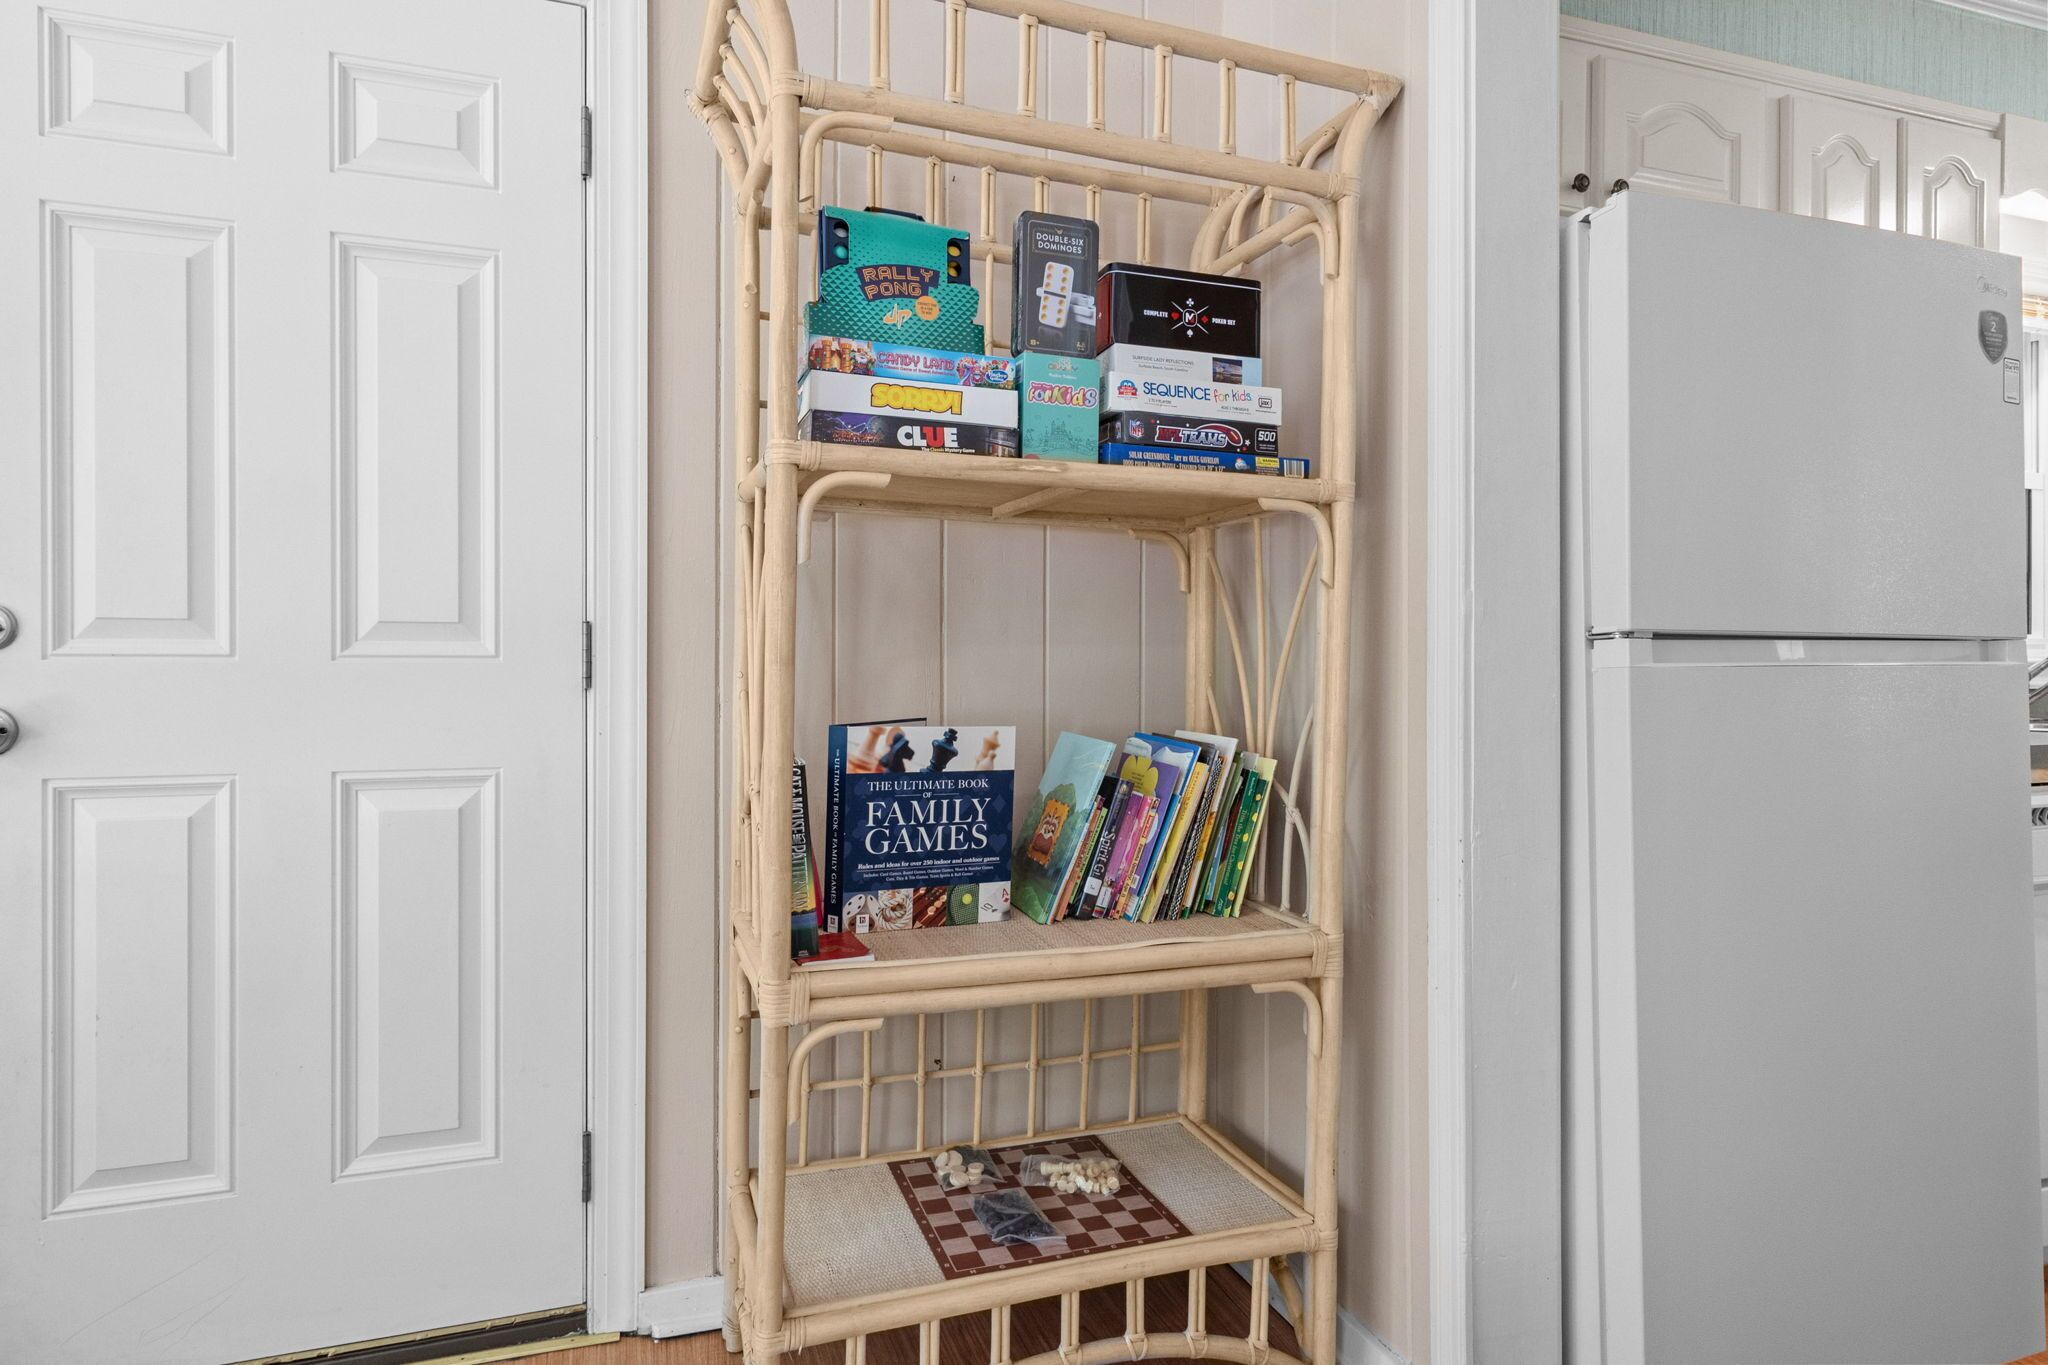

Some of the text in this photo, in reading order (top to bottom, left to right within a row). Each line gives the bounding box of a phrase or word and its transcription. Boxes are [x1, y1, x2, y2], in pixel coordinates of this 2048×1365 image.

[1036, 233, 1084, 246] DOUBLE-SIX
[1038, 241, 1082, 254] DOMINOES
[863, 266, 934, 283] RALLY
[864, 282, 922, 299] PONG
[1143, 309, 1169, 318] COMPLETE
[1212, 317, 1227, 325] POKER
[1990, 321, 1997, 332] 2
[877, 352, 955, 371] CANDY LAND
[870, 382, 963, 415] SORRY!
[1143, 382, 1211, 400] SEQUENCE
[1213, 389, 1230, 403] for
[1231, 389, 1252, 401] kids
[897, 425, 960, 447] CLUE
[1182, 430, 1227, 446] TEAMS
[1258, 430, 1276, 441] 500
[867, 778, 989, 791] THE ULTIMATE BOOK
[865, 797, 992, 827] FAMILY
[865, 823, 988, 855] GAMES
[1096, 830, 1116, 865] Spirit
[830, 872, 838, 904] GAMES
